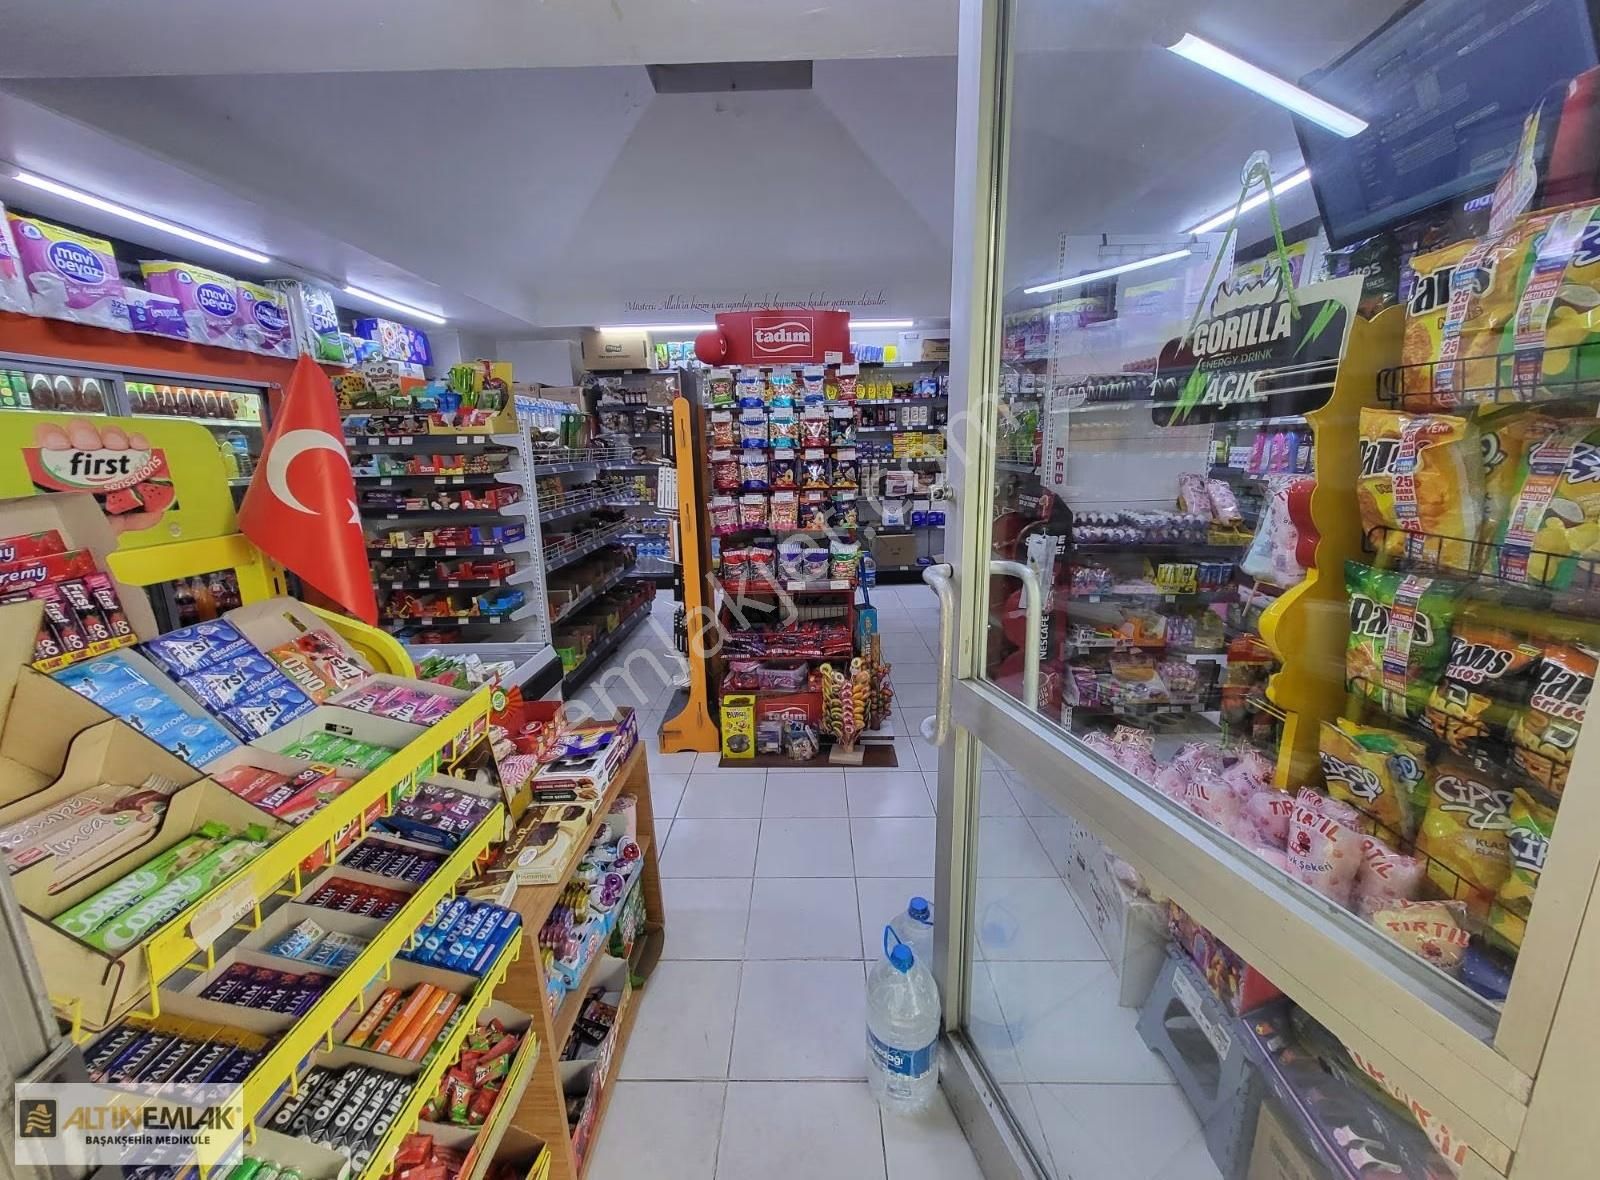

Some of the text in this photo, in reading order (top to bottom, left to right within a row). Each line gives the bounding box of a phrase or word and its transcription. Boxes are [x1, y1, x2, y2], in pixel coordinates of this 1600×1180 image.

[54, 253, 105, 278] beyaz
[57, 247, 95, 266] mavi
[200, 287, 230, 302] mavi
[755, 328, 810, 343] tadım
[1192, 303, 1292, 357] GORILLA
[1202, 349, 1273, 370] ENERGY DRINK
[70, 452, 131, 476] first
[103, 454, 163, 491] sensations
[1396, 475, 1414, 488] 25
[86, 1030, 137, 1074] FALIM
[112, 1036, 164, 1081] FALIM
[144, 1042, 193, 1088] FALIM
